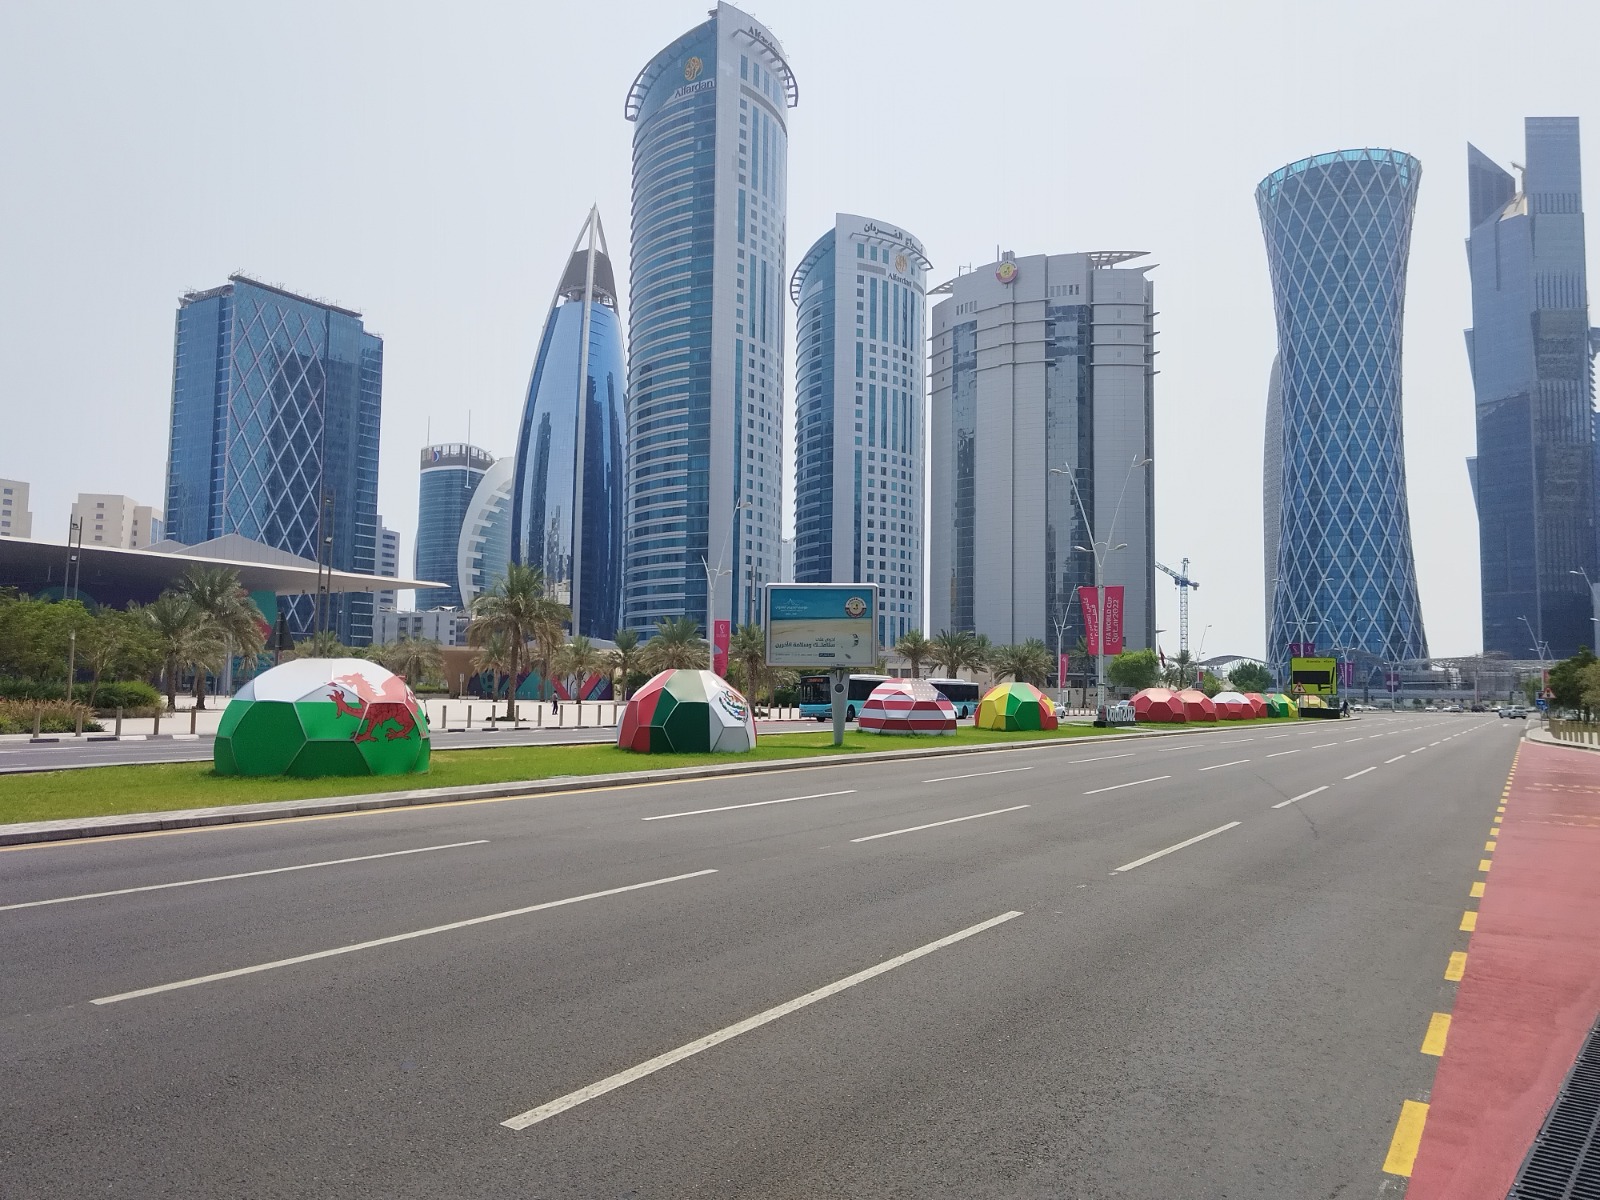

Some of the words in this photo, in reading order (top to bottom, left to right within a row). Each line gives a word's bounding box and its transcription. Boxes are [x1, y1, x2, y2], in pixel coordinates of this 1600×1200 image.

[675, 80, 713, 98] Alfardan
[863, 222, 903, 241] الفردان
[887, 272, 912, 288] Alfardan
